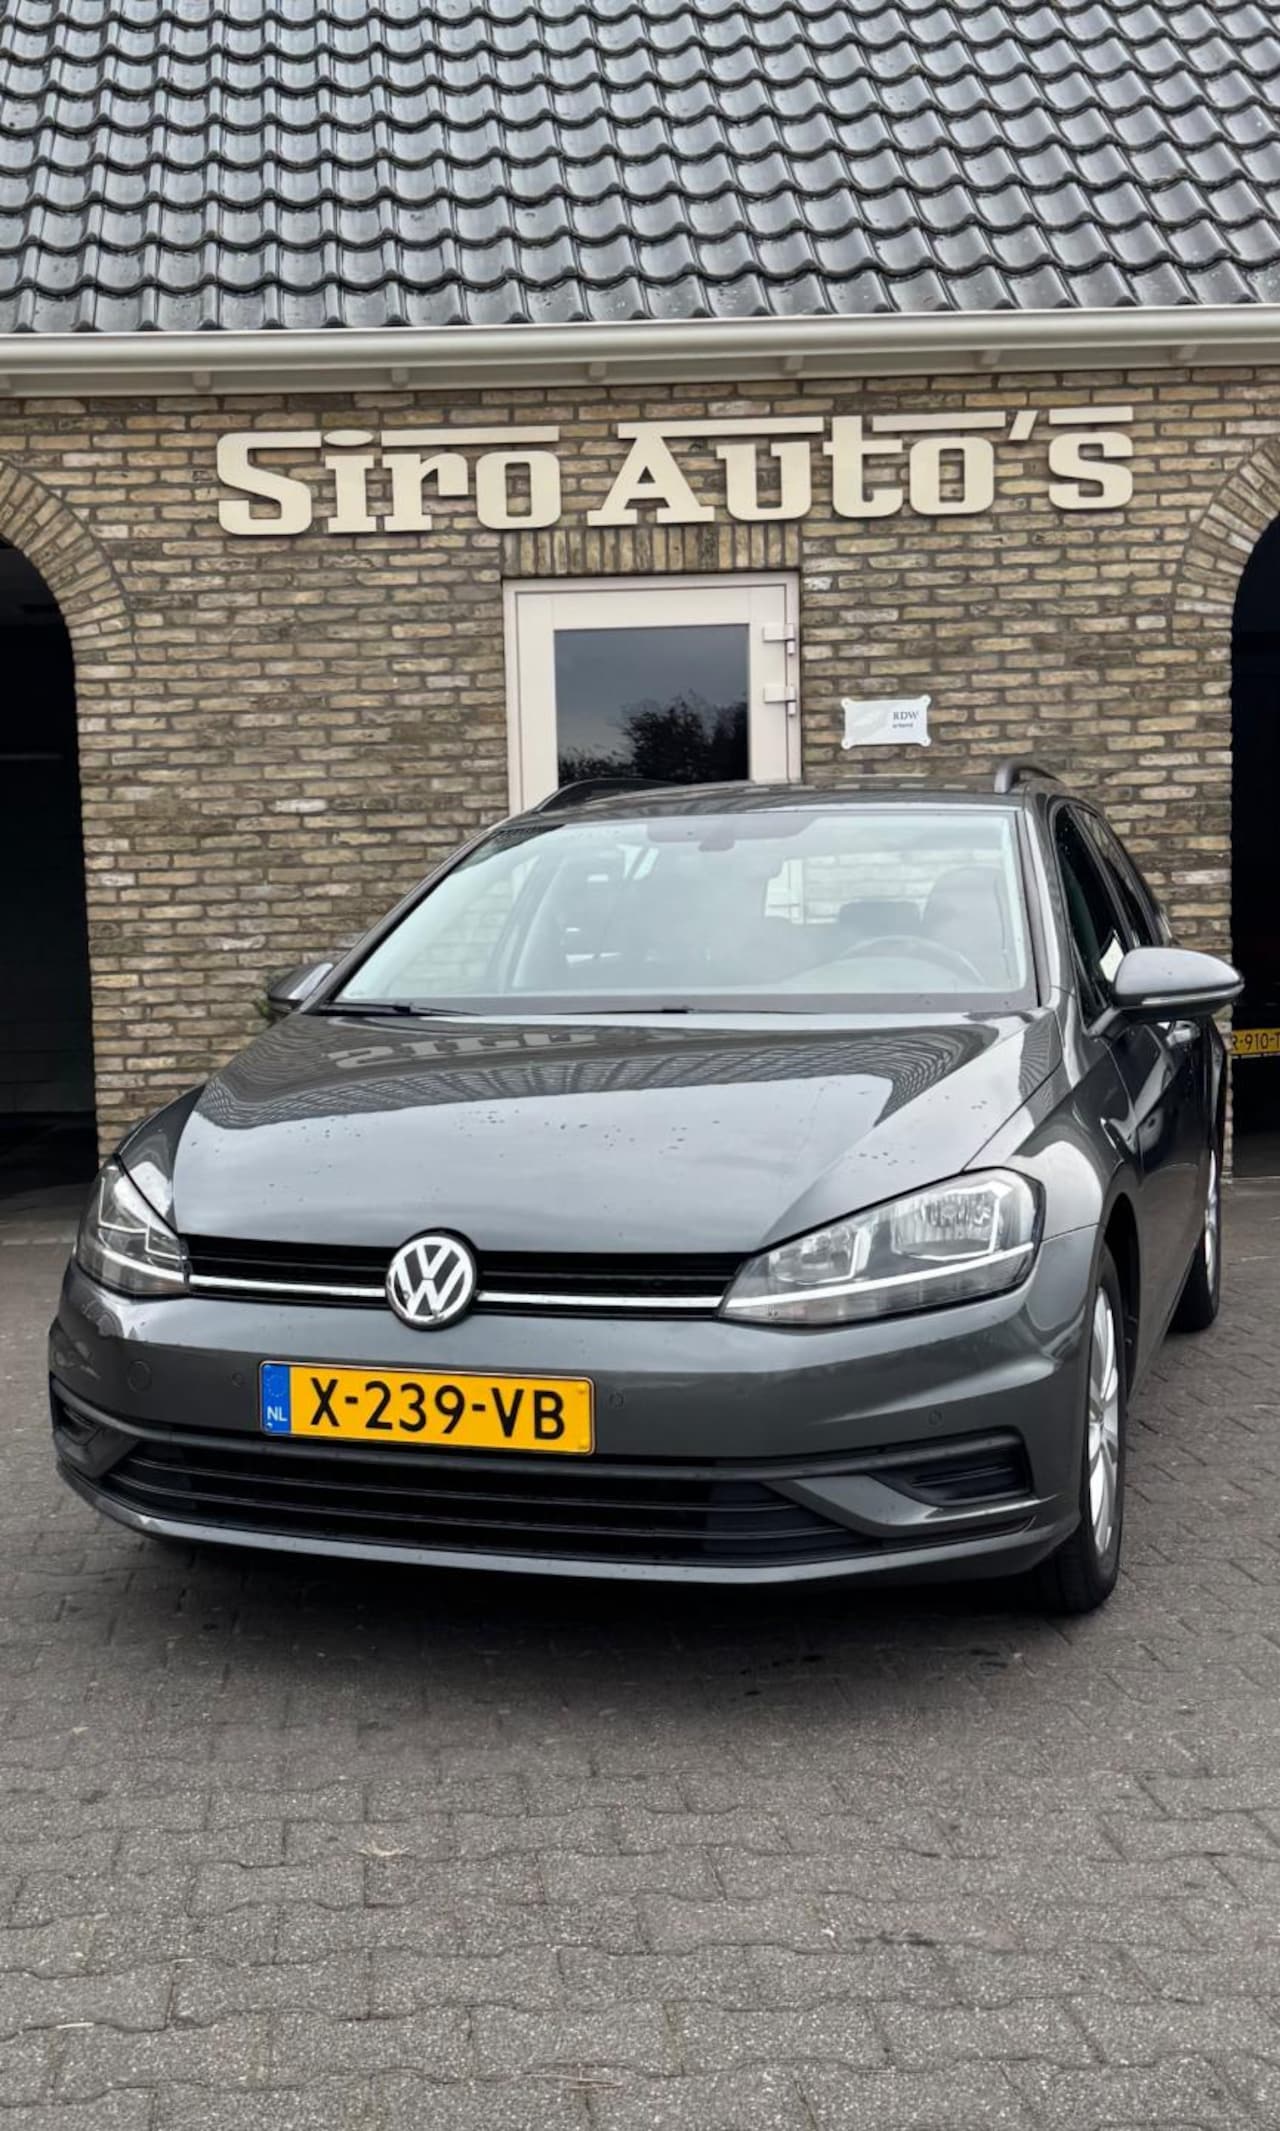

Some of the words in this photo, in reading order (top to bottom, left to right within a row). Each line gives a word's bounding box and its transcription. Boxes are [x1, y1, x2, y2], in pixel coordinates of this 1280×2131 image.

[217, 425, 560, 535] Siro
[587, 406, 1133, 526] Auto's
[893, 711, 919, 721] RDW
[266, 1405, 288, 1422] NL
[309, 1377, 566, 1441] X-239-VB
